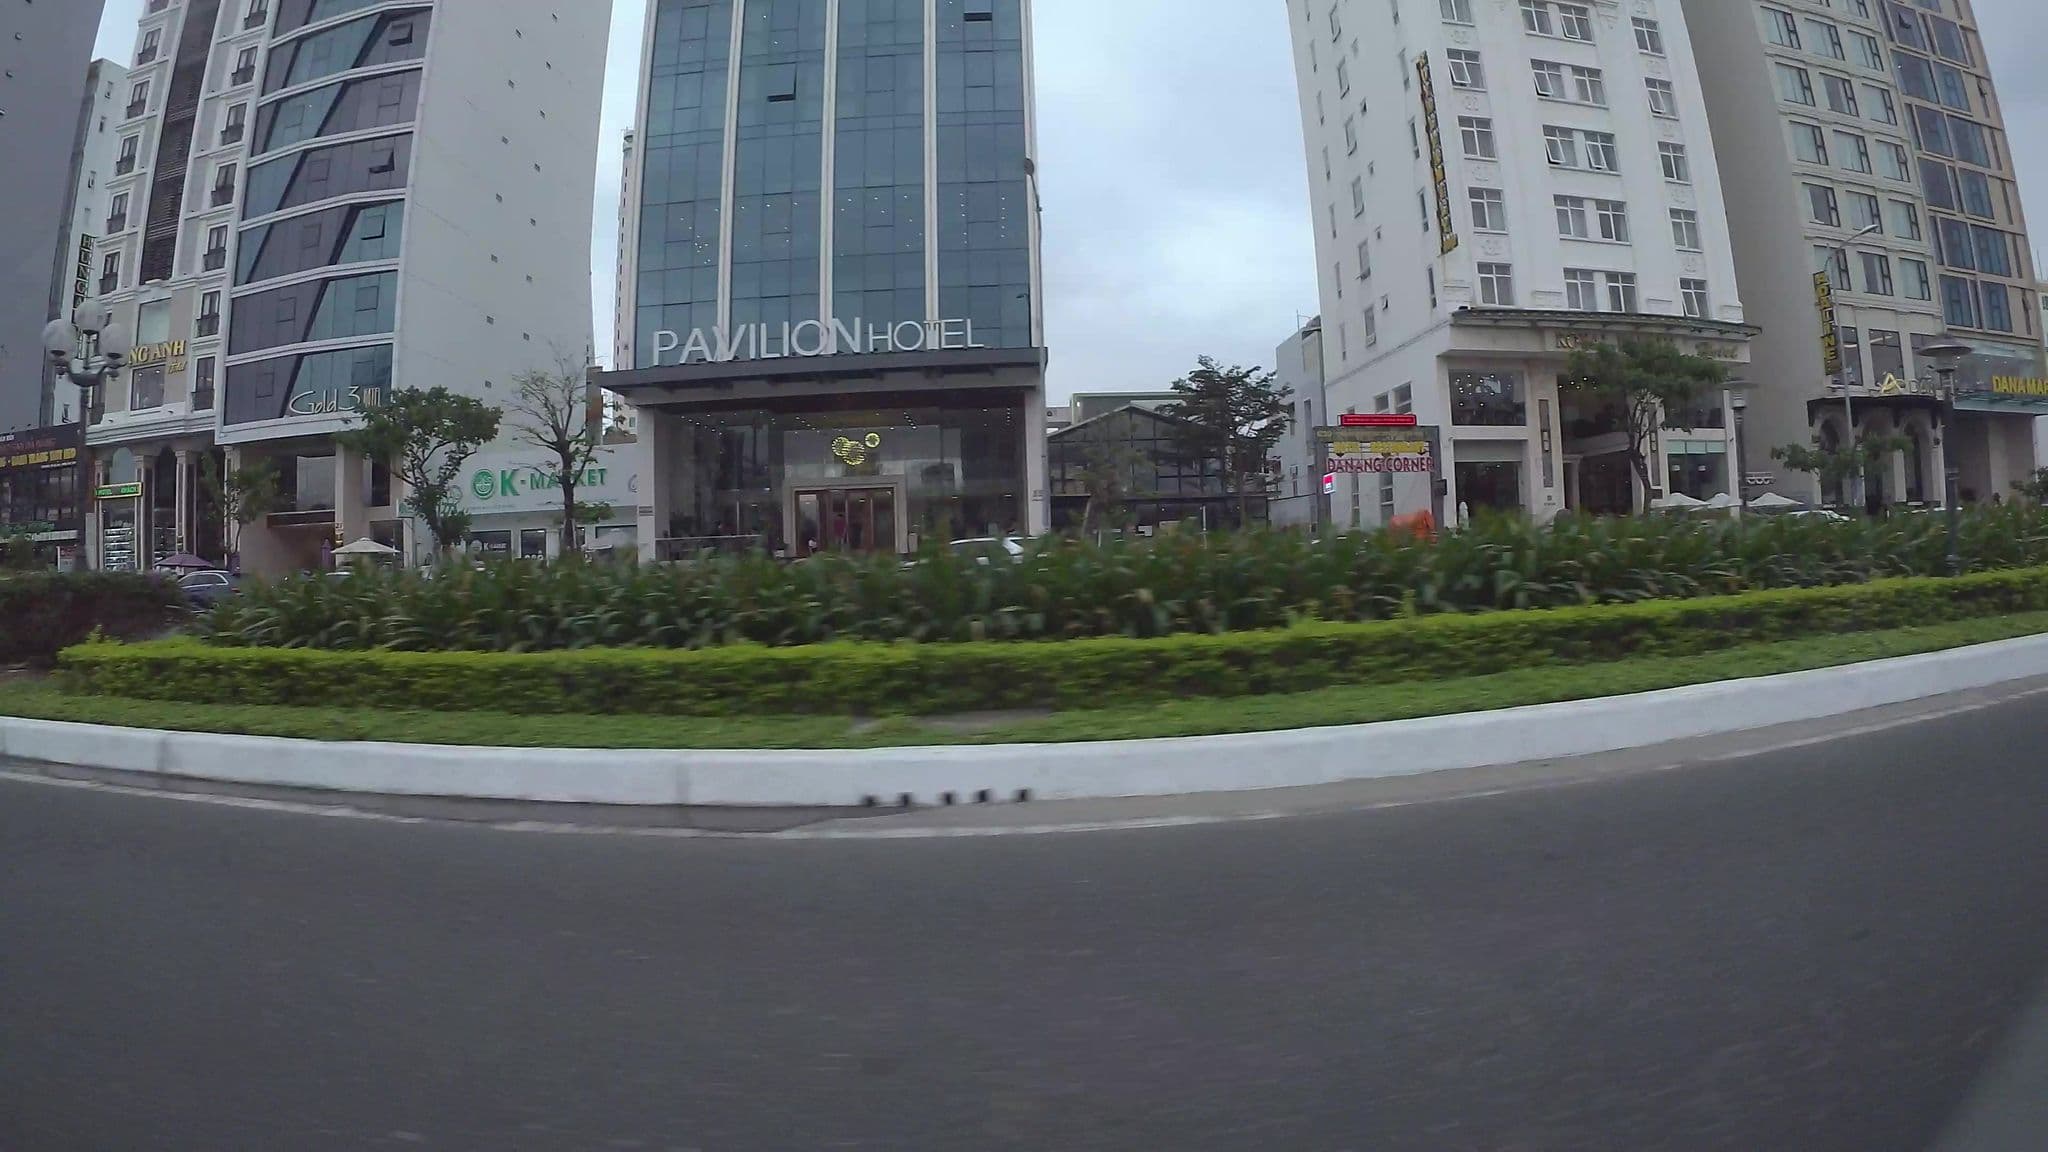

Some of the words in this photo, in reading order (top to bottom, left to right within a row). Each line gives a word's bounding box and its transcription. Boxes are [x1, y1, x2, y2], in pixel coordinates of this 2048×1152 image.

[152, 339, 187, 360] ANH
[652, 316, 862, 367] PAVILION
[868, 318, 985, 352] HOTEL
[289, 389, 338, 415] Gold
[338, 385, 361, 412] 3
[1327, 457, 1382, 473] DANANG
[1385, 456, 1435, 473] CORNER
